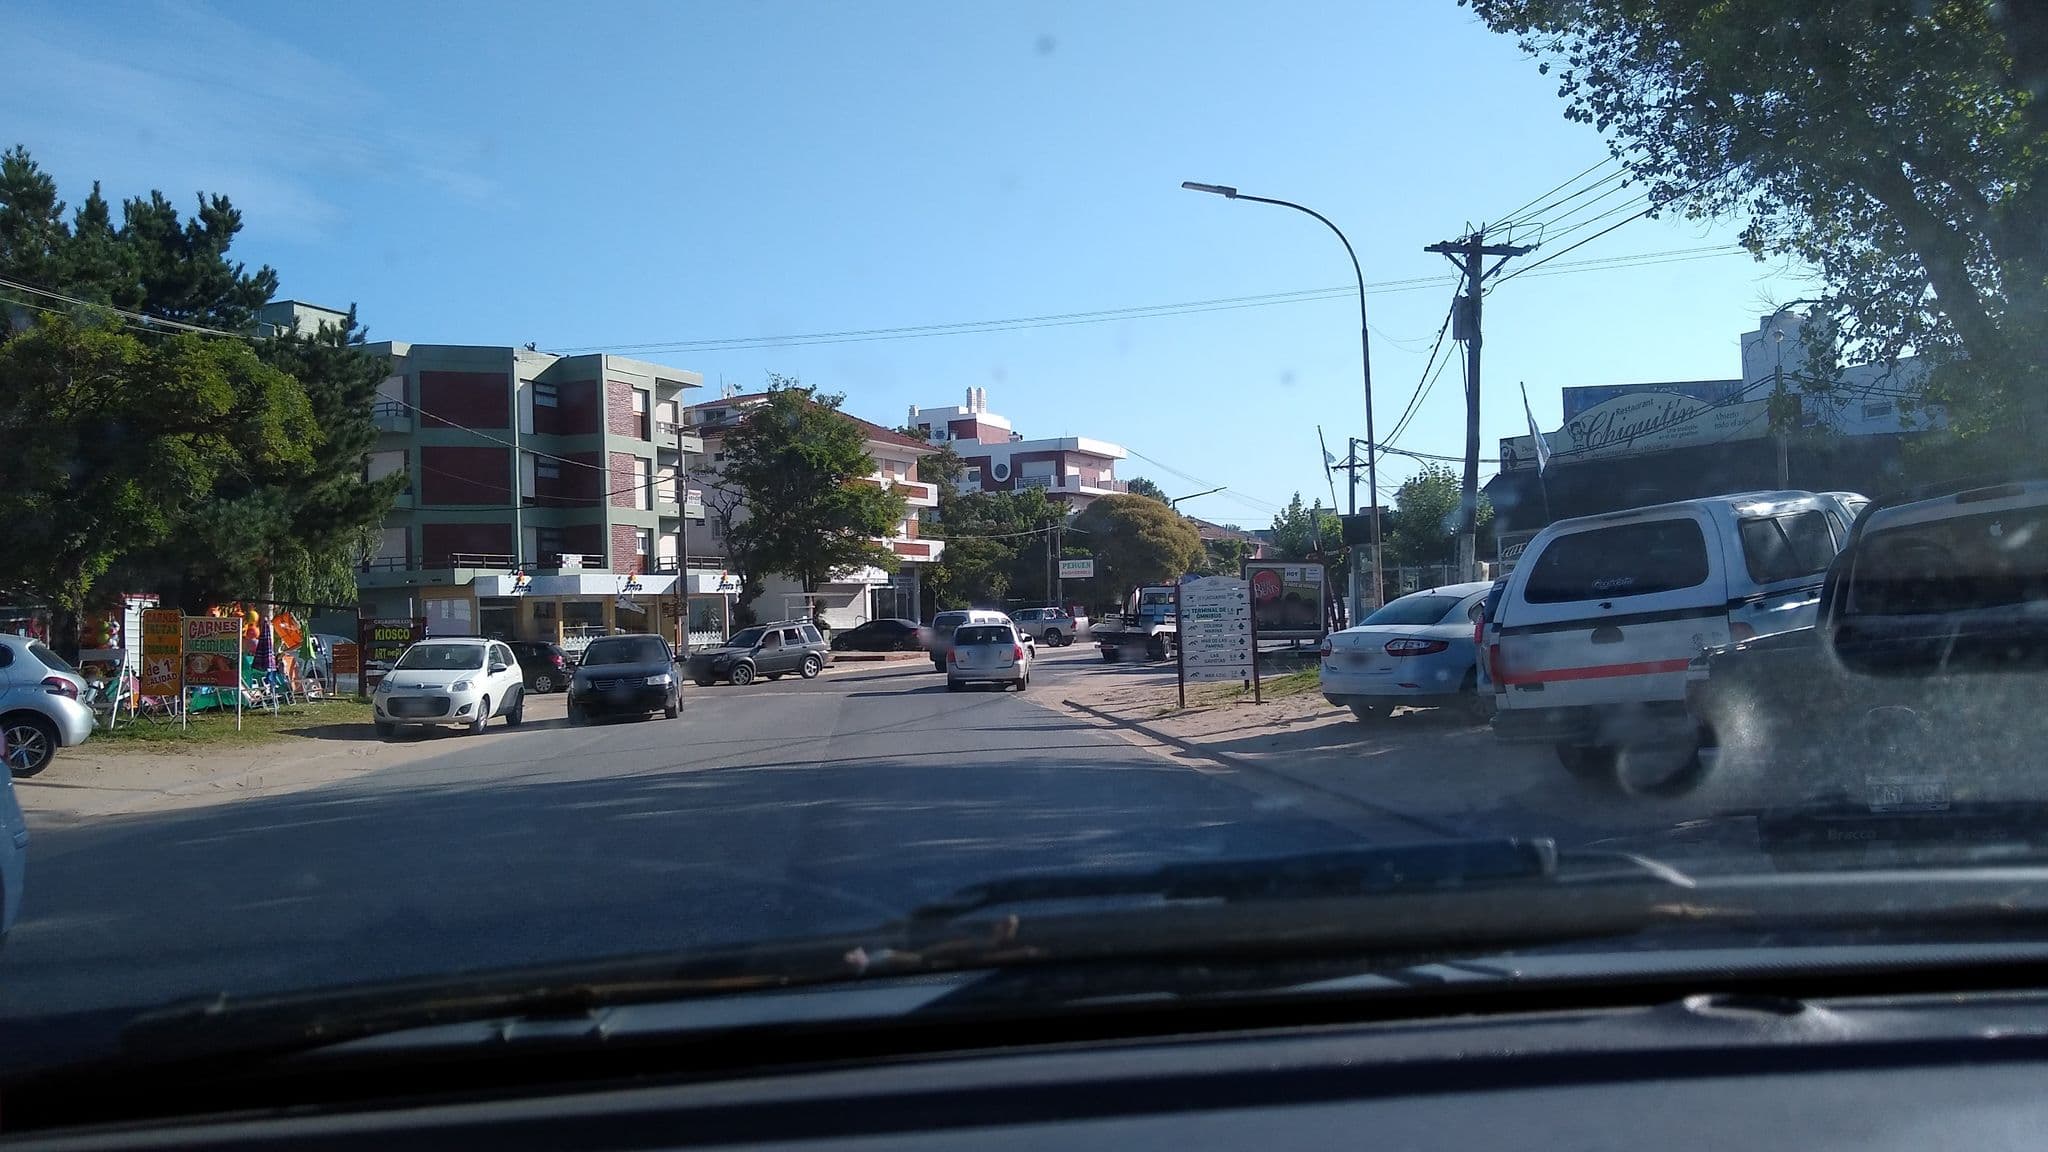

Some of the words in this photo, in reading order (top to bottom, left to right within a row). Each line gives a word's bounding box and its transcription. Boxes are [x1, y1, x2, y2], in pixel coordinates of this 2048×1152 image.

[1615, 398, 1653, 416] Restaurant
[189, 621, 238, 639] CARNES
[375, 629, 410, 641] KIOSCO
[146, 664, 160, 677] de
